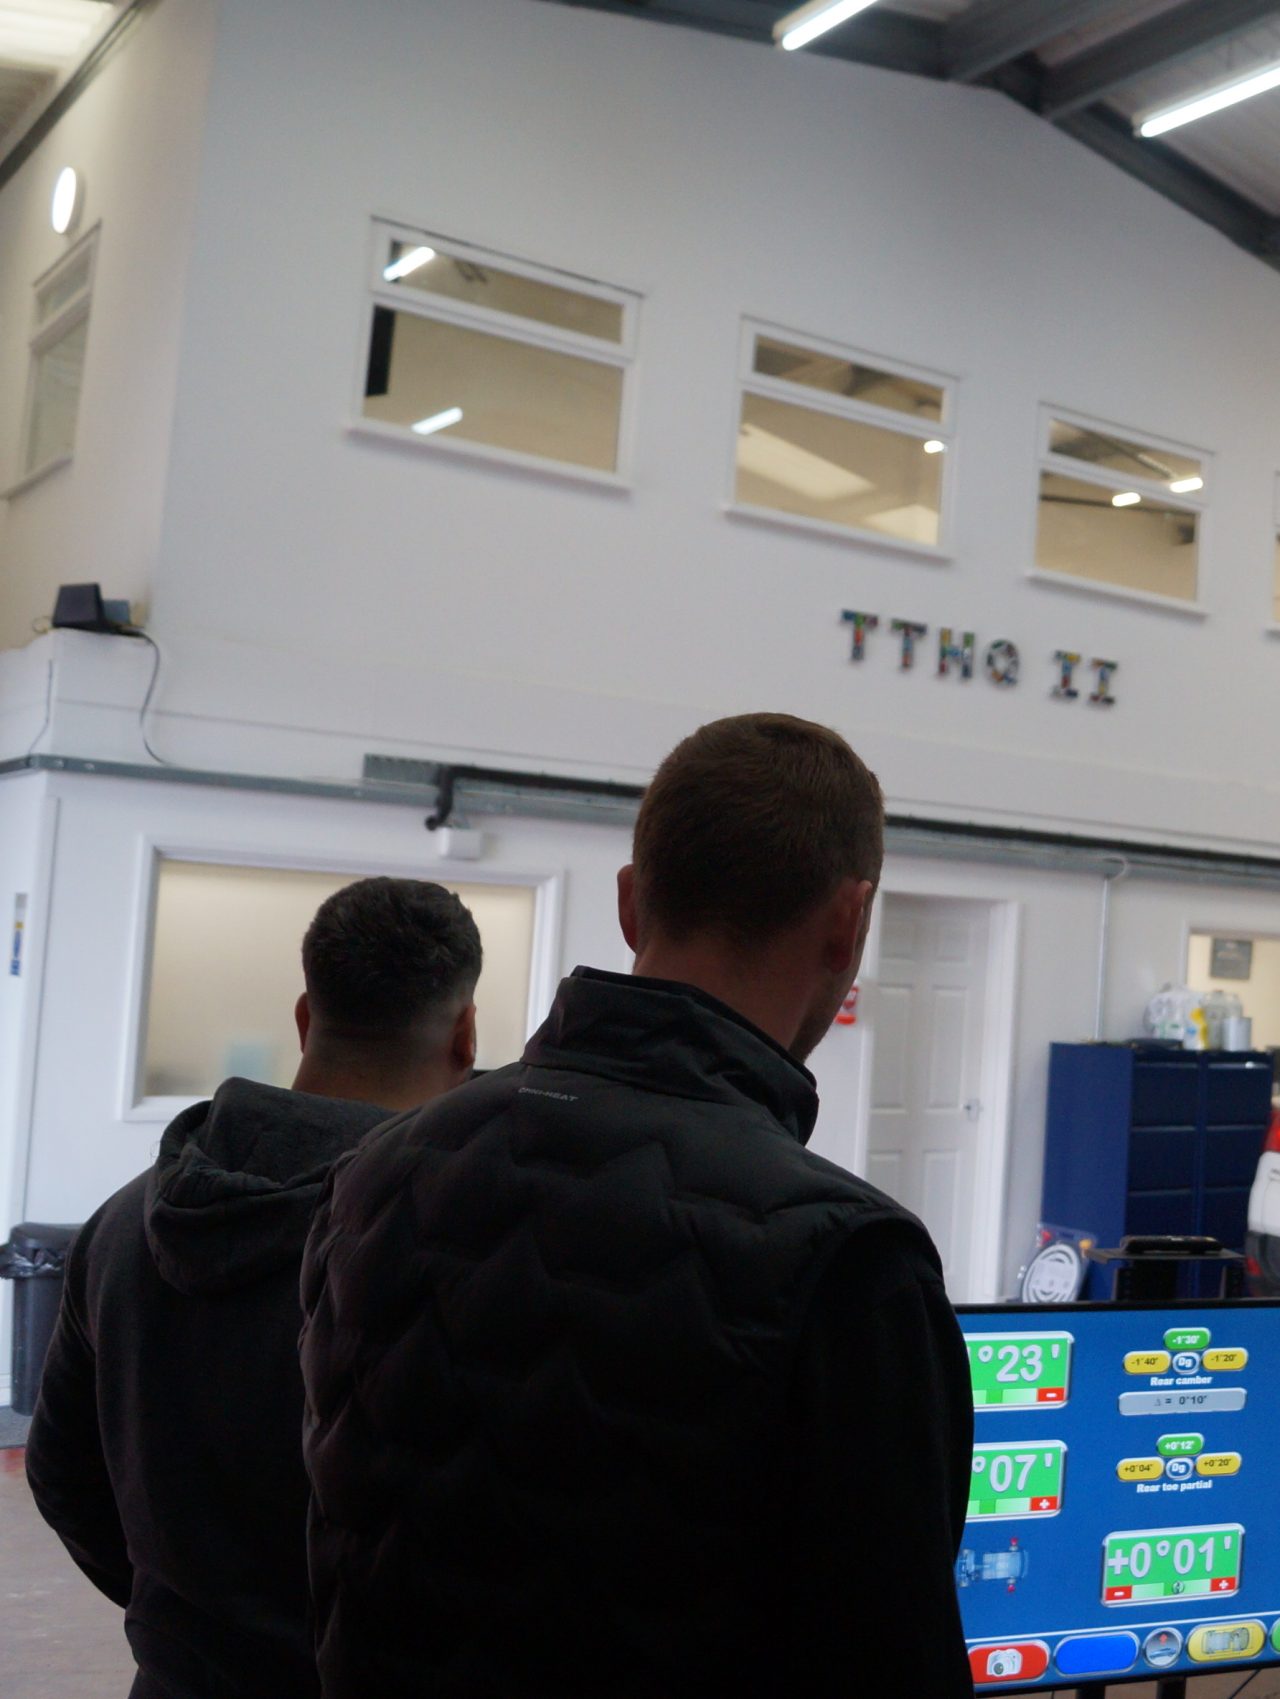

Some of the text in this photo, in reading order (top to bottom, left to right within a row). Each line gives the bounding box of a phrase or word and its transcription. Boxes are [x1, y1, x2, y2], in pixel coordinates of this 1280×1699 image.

[840, 609, 1118, 706] TTHQ II
[1150, 1376, 1213, 1386] Rear camber
[1137, 1480, 1213, 1493] Rear toe partial
